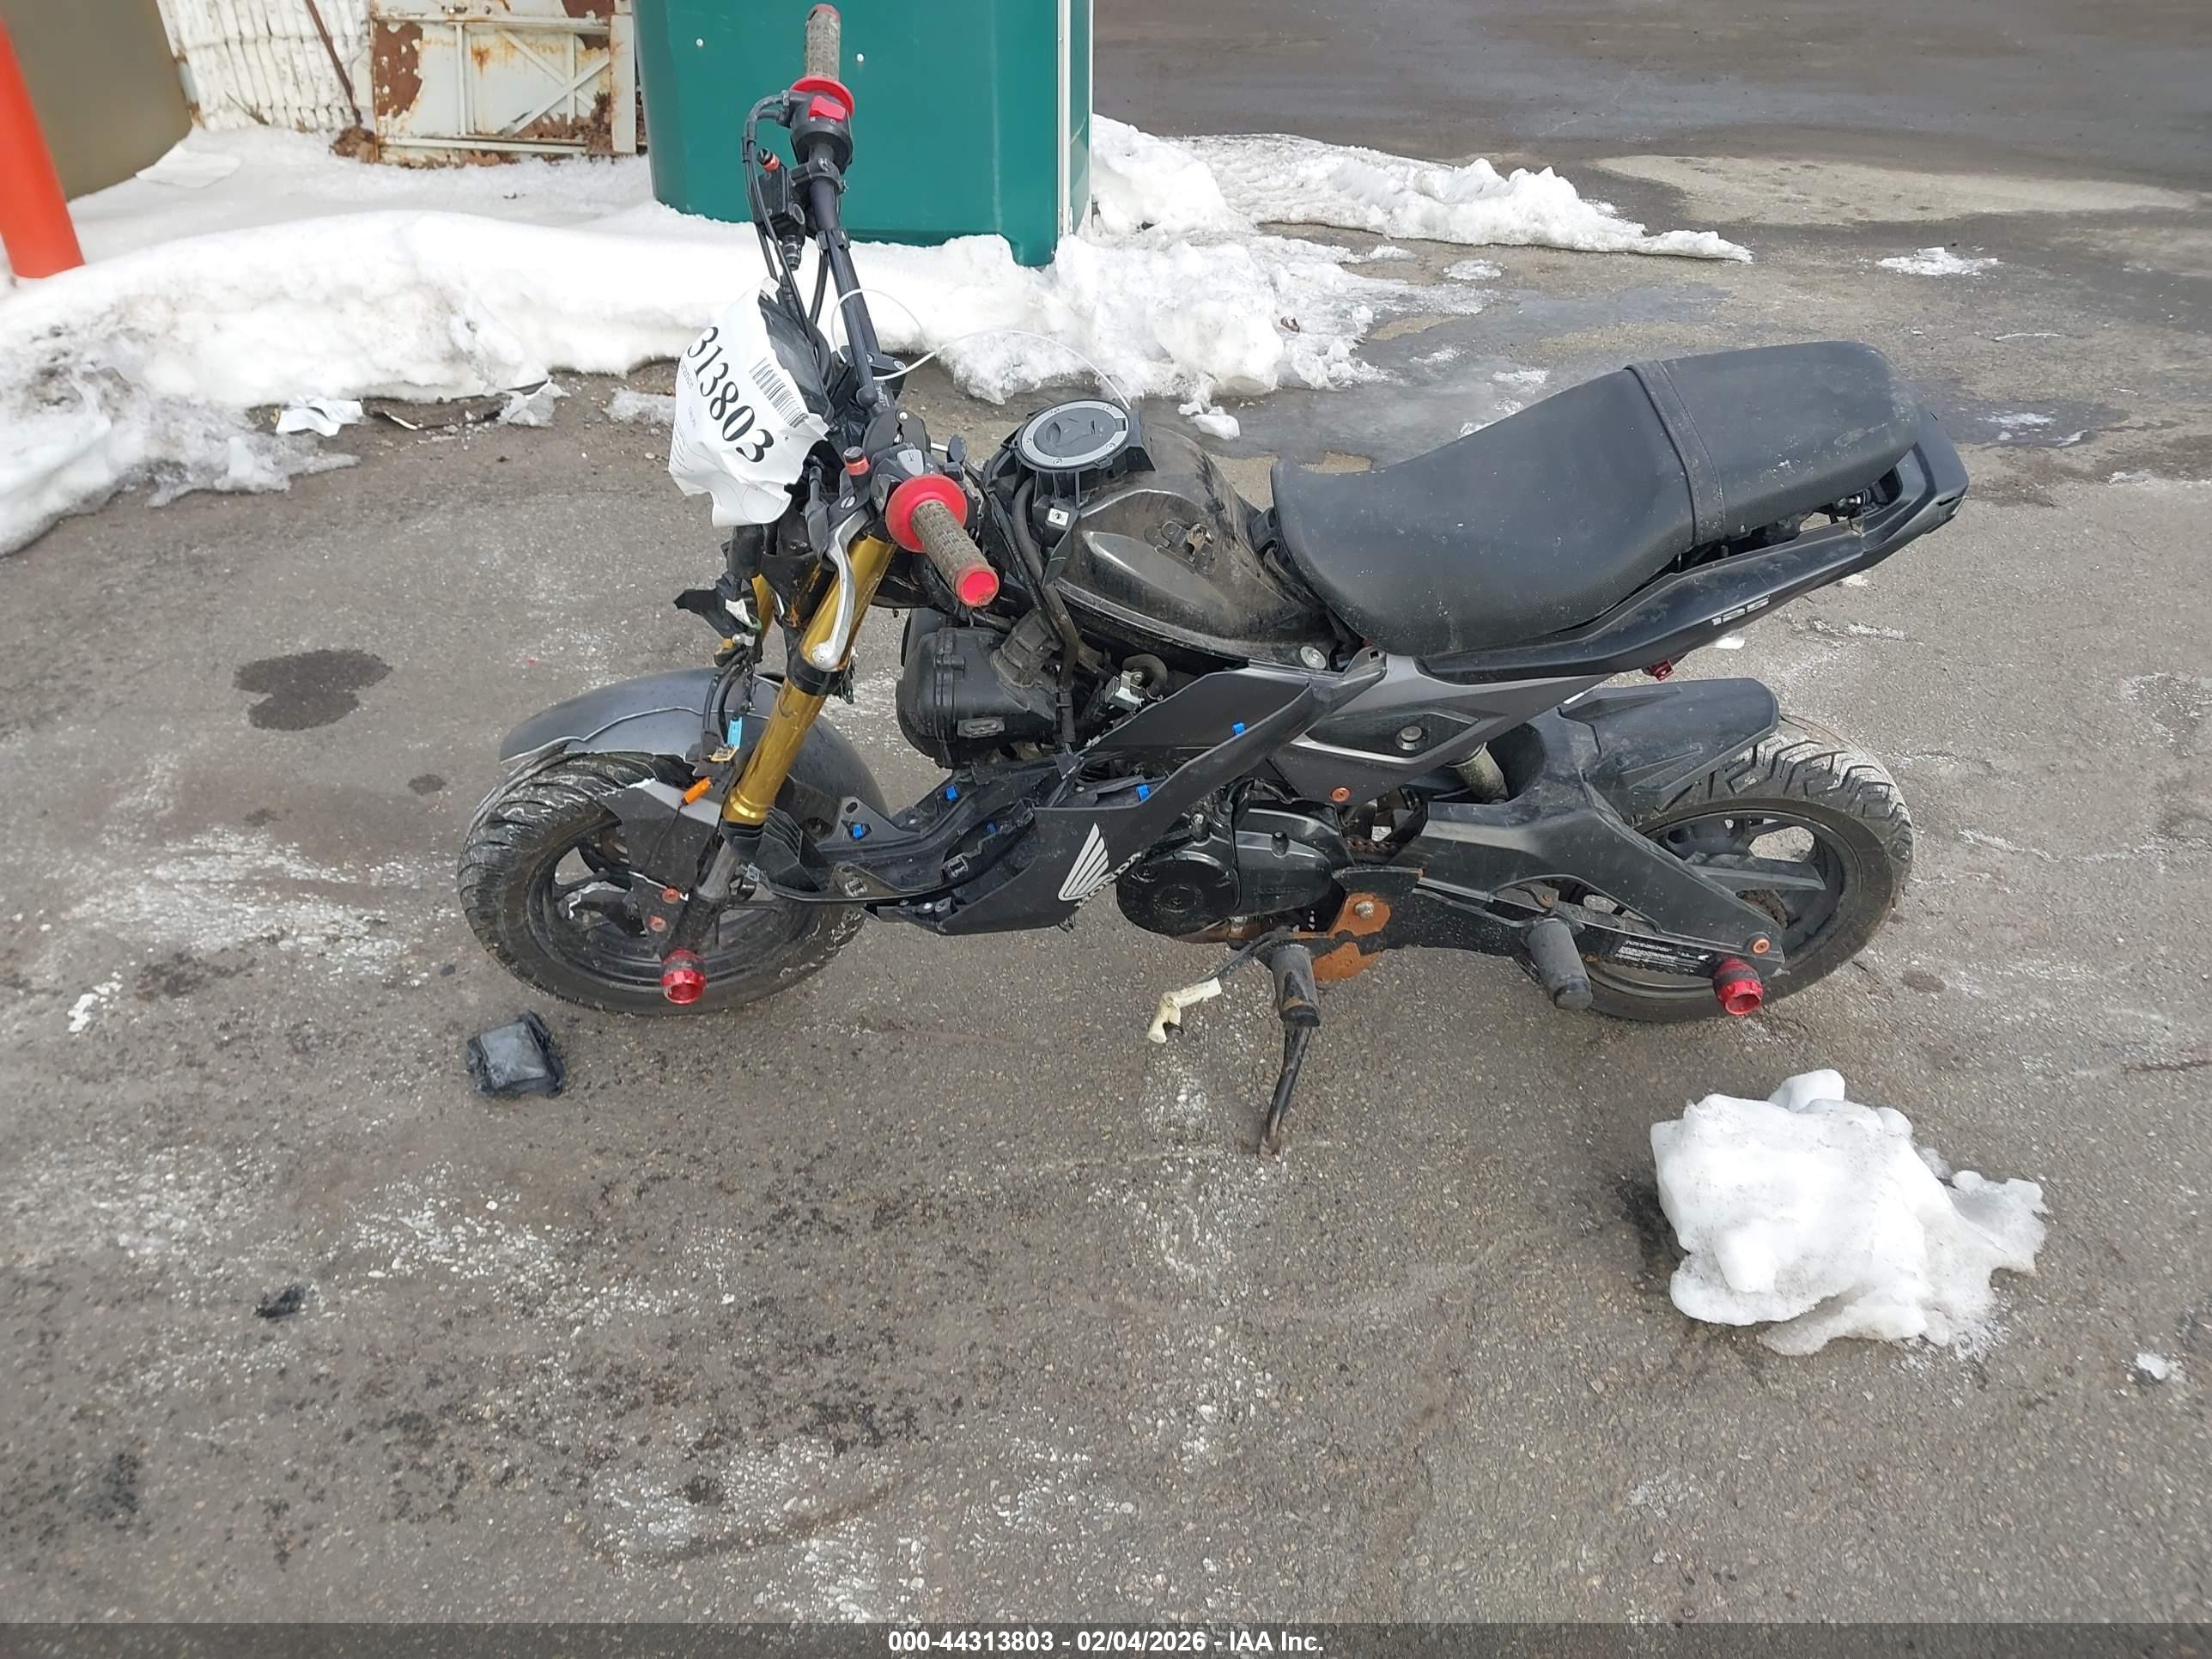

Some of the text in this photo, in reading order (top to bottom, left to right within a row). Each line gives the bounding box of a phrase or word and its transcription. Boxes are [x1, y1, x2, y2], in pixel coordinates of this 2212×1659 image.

[687, 326, 775, 463] 313803
[1711, 594, 1771, 626] 125
[1073, 851, 1143, 906] HONDA
